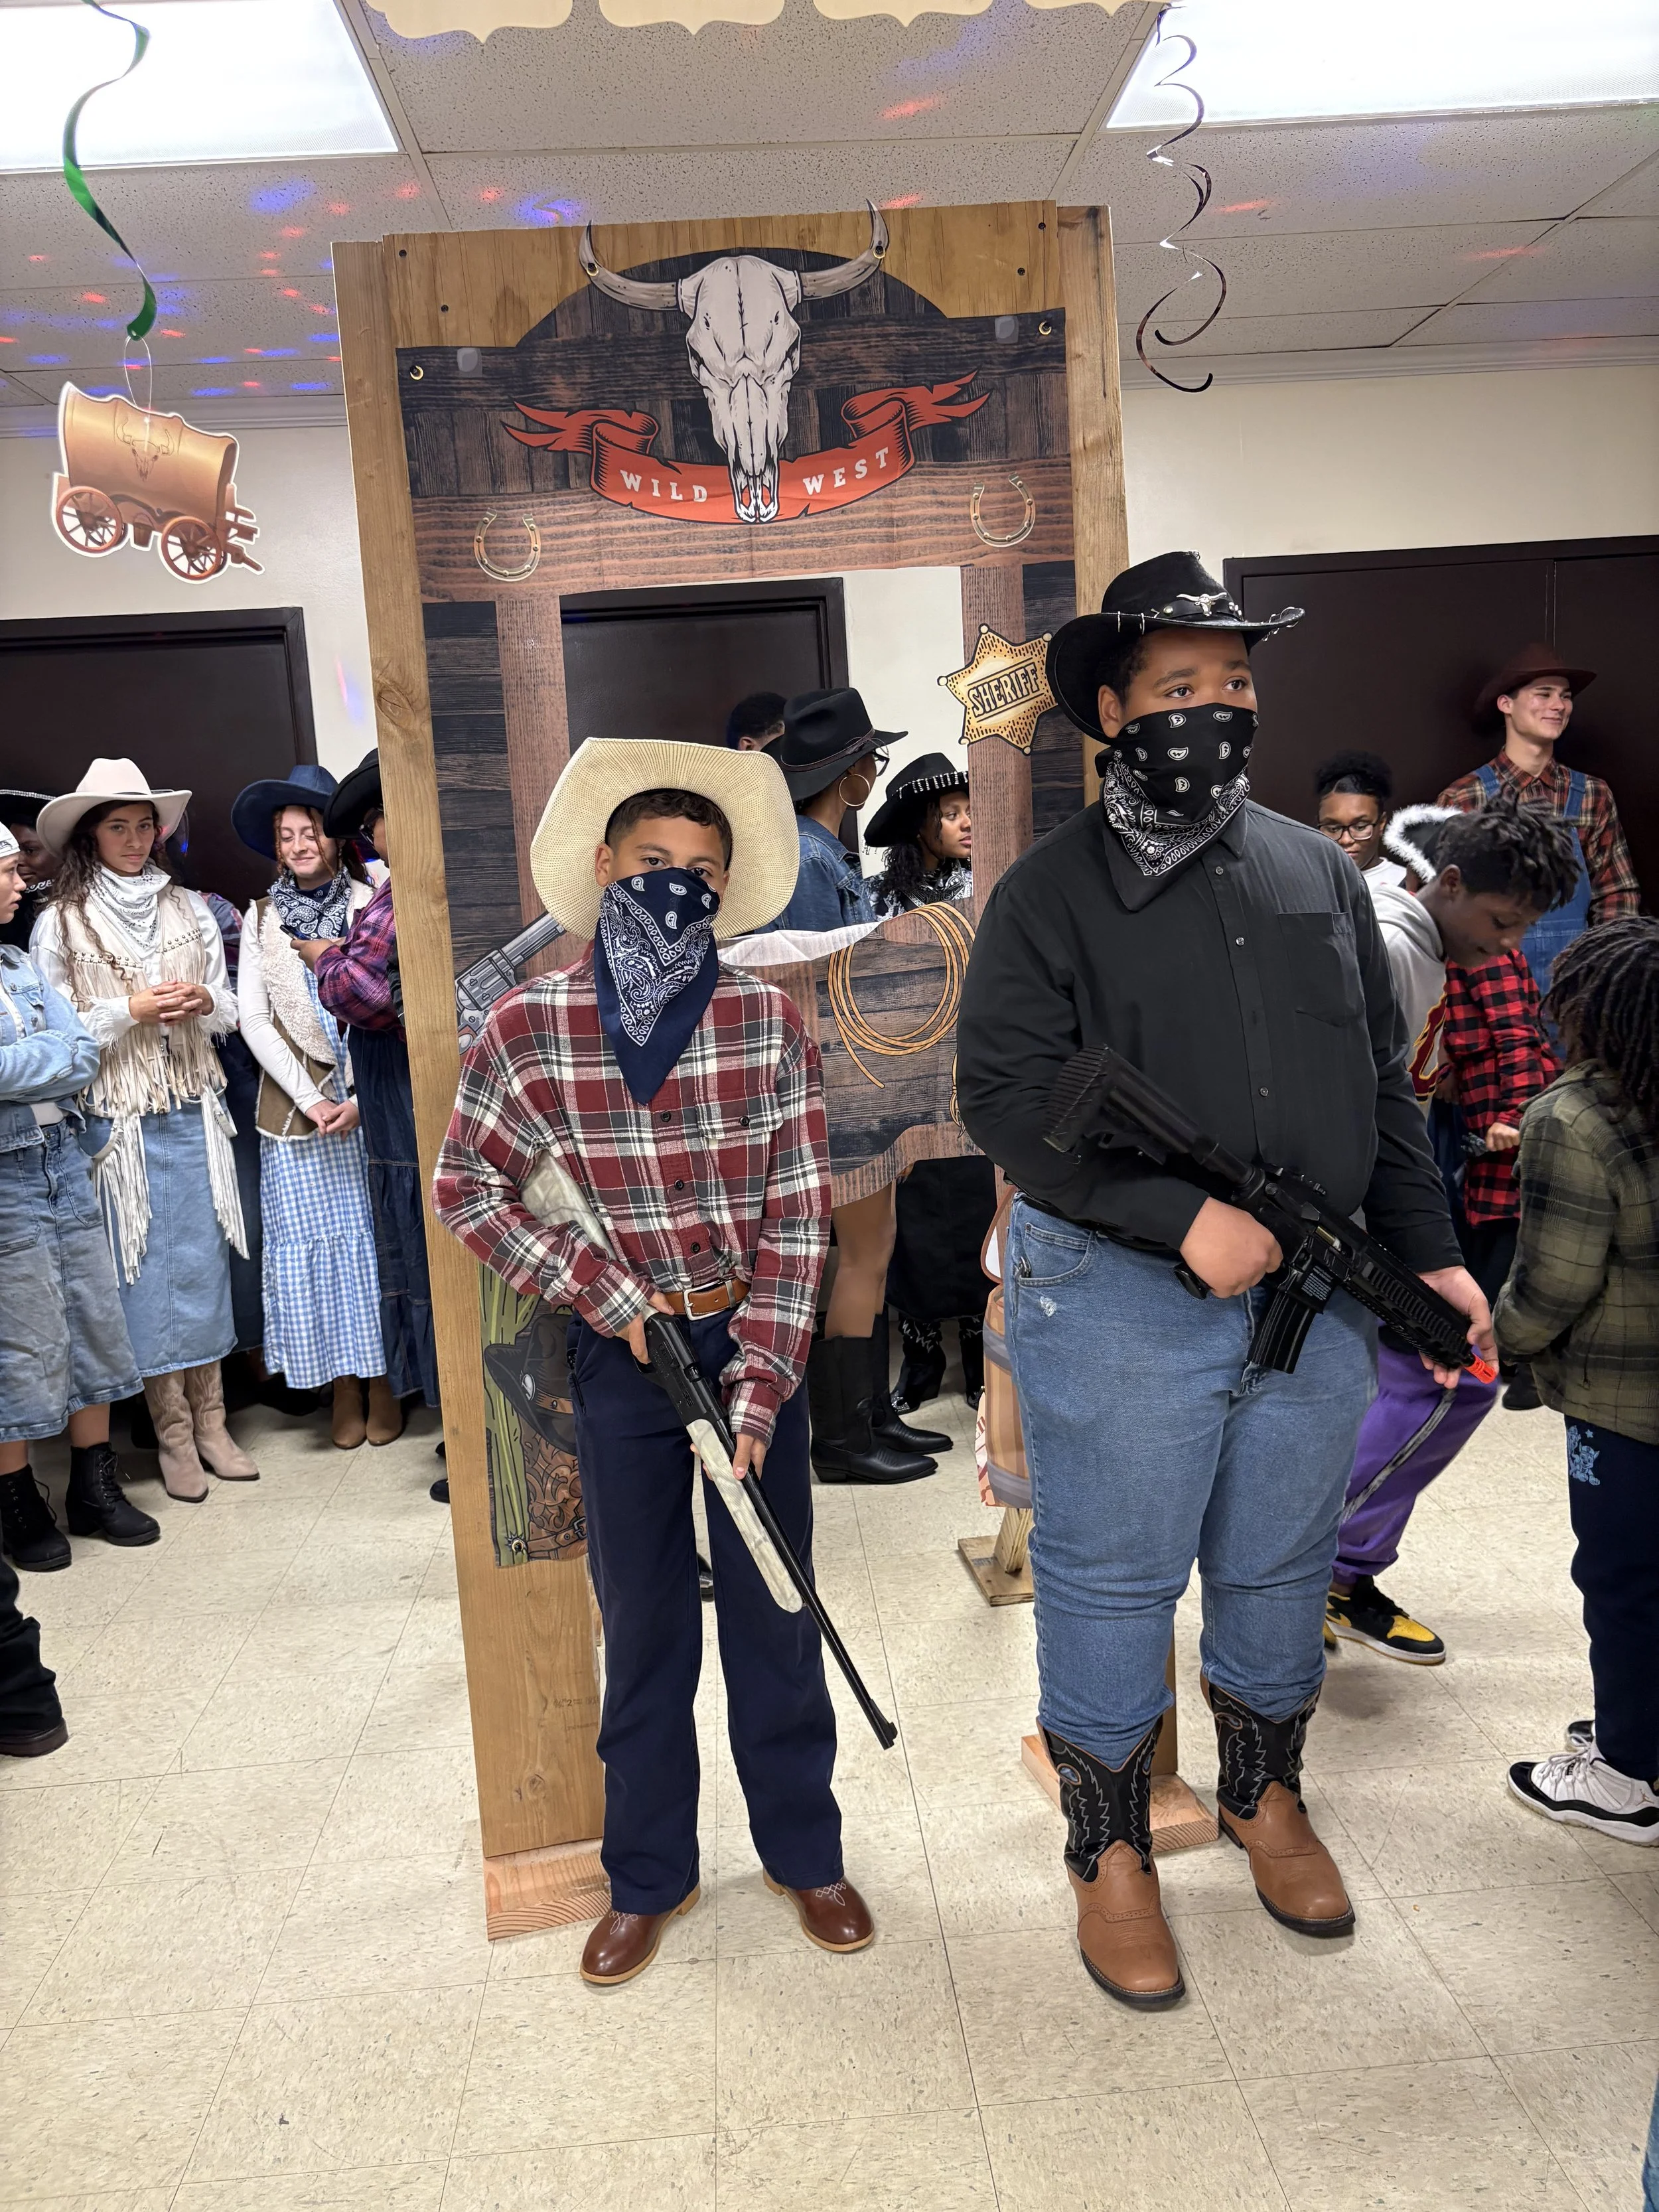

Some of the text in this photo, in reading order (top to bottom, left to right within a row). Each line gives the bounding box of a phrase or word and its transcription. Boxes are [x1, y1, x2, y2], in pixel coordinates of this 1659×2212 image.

[620, 447, 889, 502] WILD WEST
[968, 662, 1040, 717] SHERIFF
